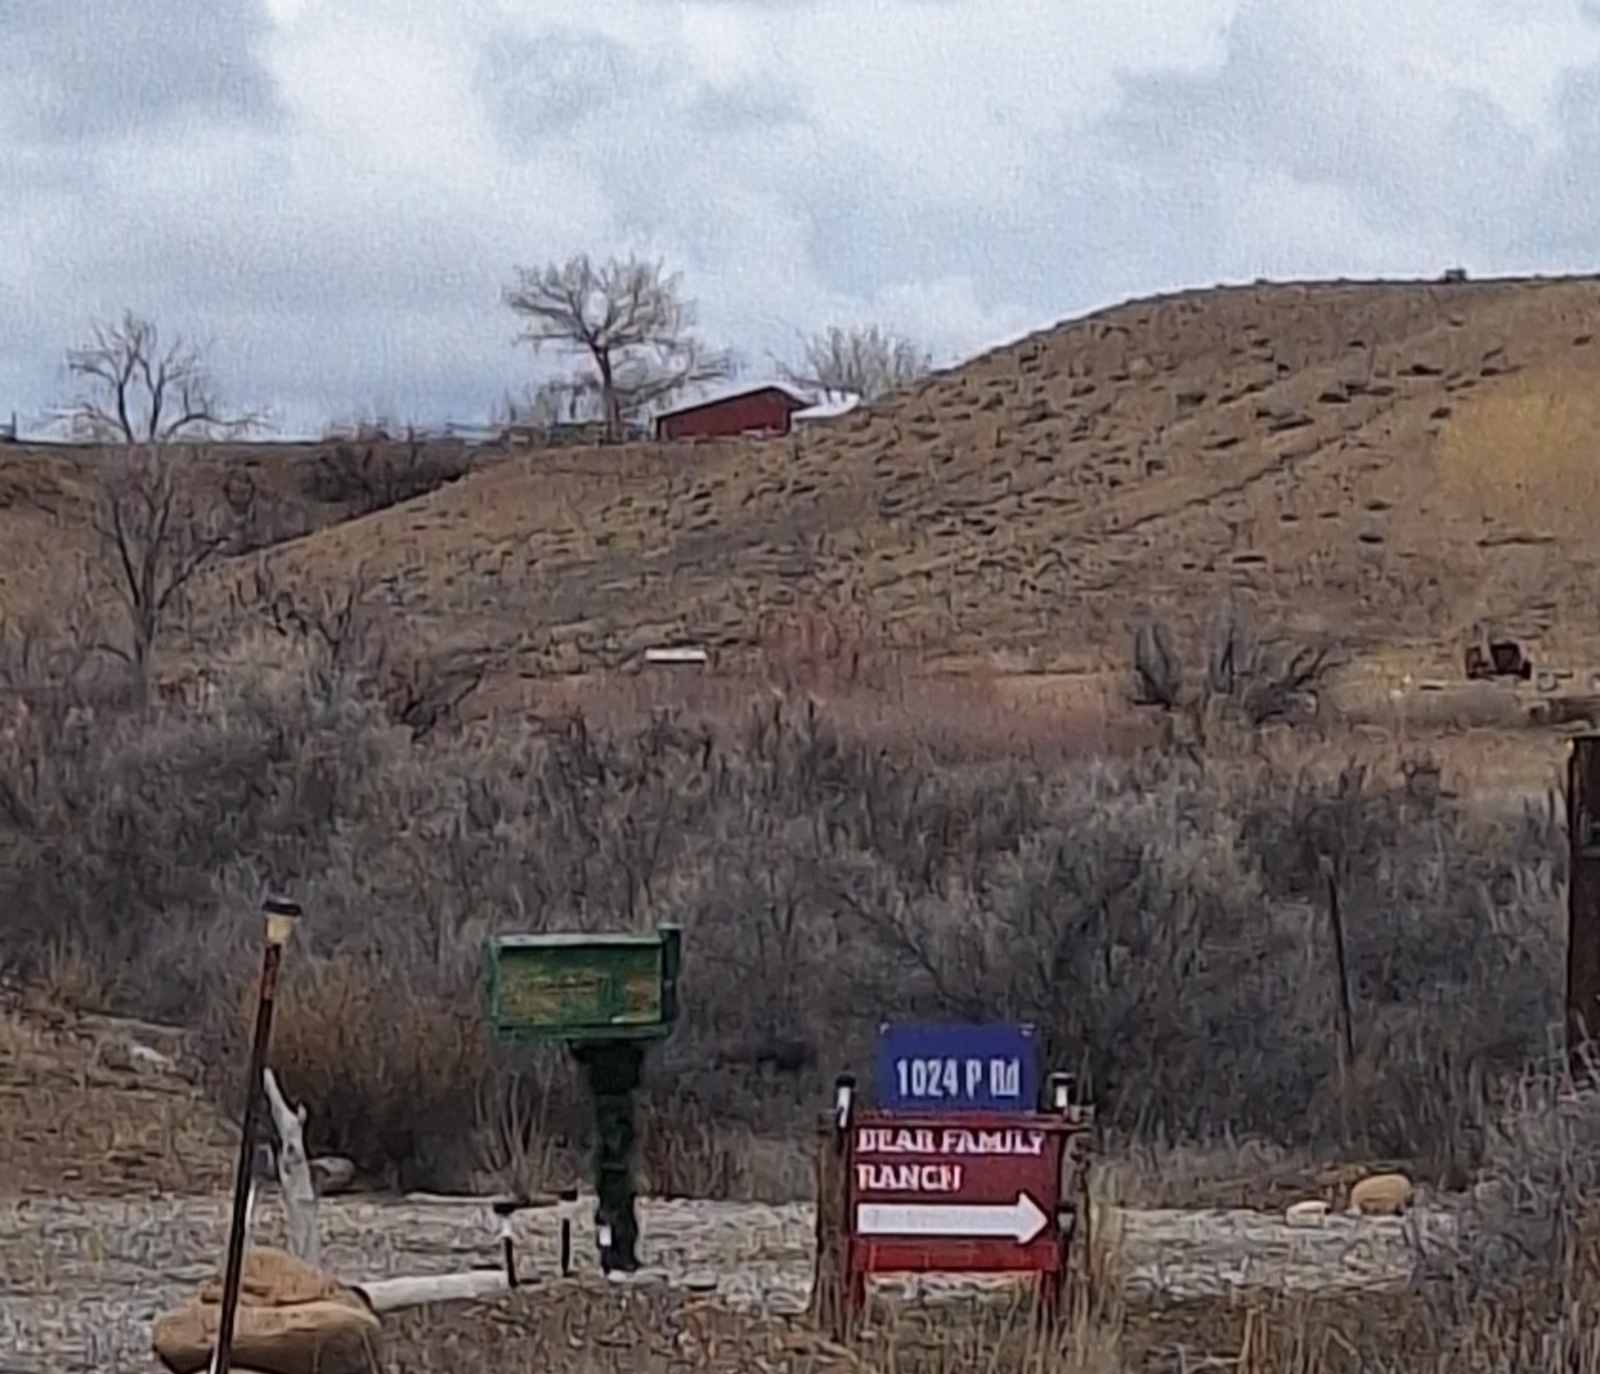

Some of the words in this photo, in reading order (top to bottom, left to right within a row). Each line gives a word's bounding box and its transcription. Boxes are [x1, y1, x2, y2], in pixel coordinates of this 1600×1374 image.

[896, 1058, 959, 1097] 1024
[965, 1058, 983, 1099] P
[940, 1129, 1045, 1155] FAMILY
[856, 1163, 962, 1191] RANCH
